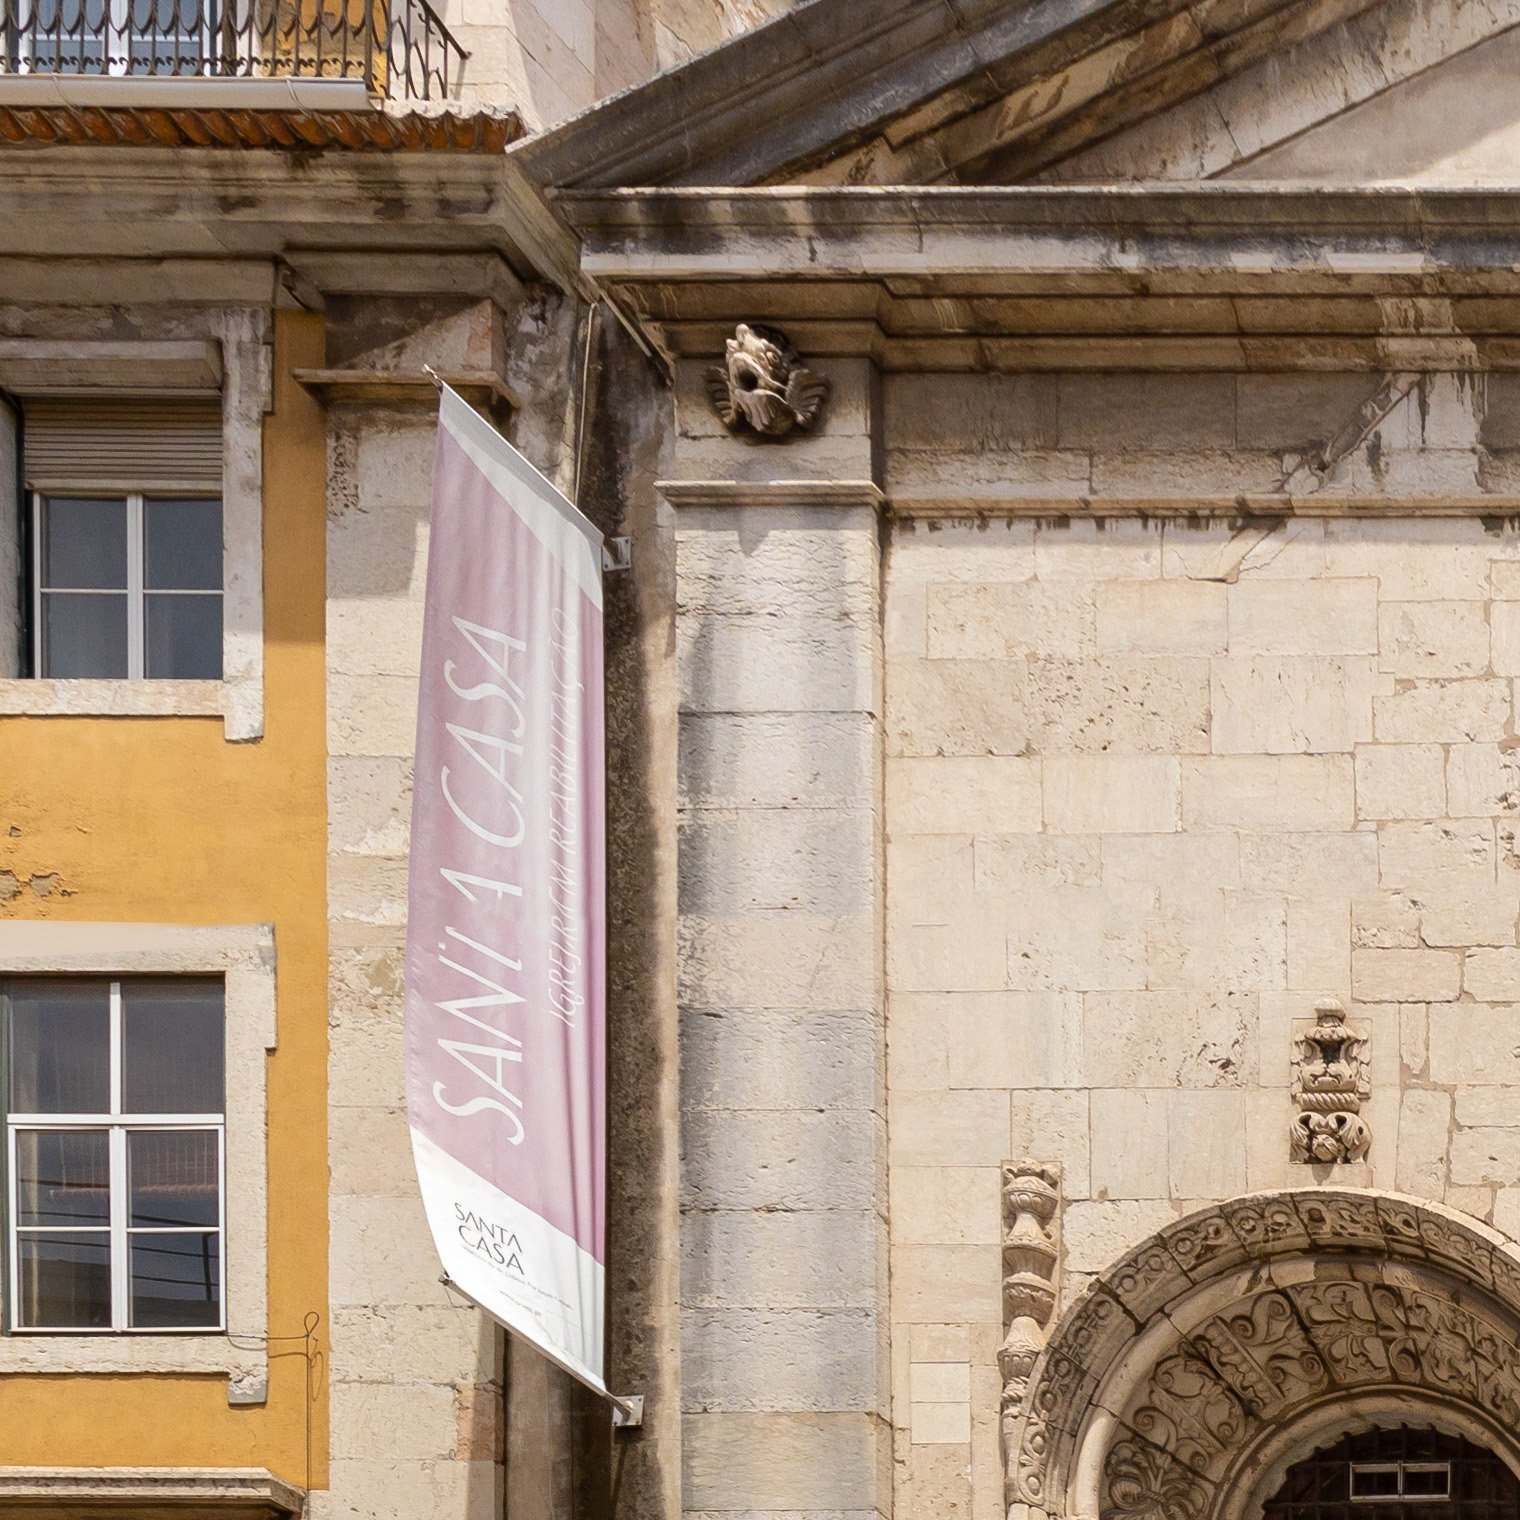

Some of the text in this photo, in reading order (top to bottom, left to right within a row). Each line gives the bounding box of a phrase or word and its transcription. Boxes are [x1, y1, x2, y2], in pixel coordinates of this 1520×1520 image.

[440, 614, 527, 848] CASA
[547, 925, 585, 1030] IGREJ
[454, 1202, 523, 1254] SANTA
[458, 1225, 525, 1276] CASA
